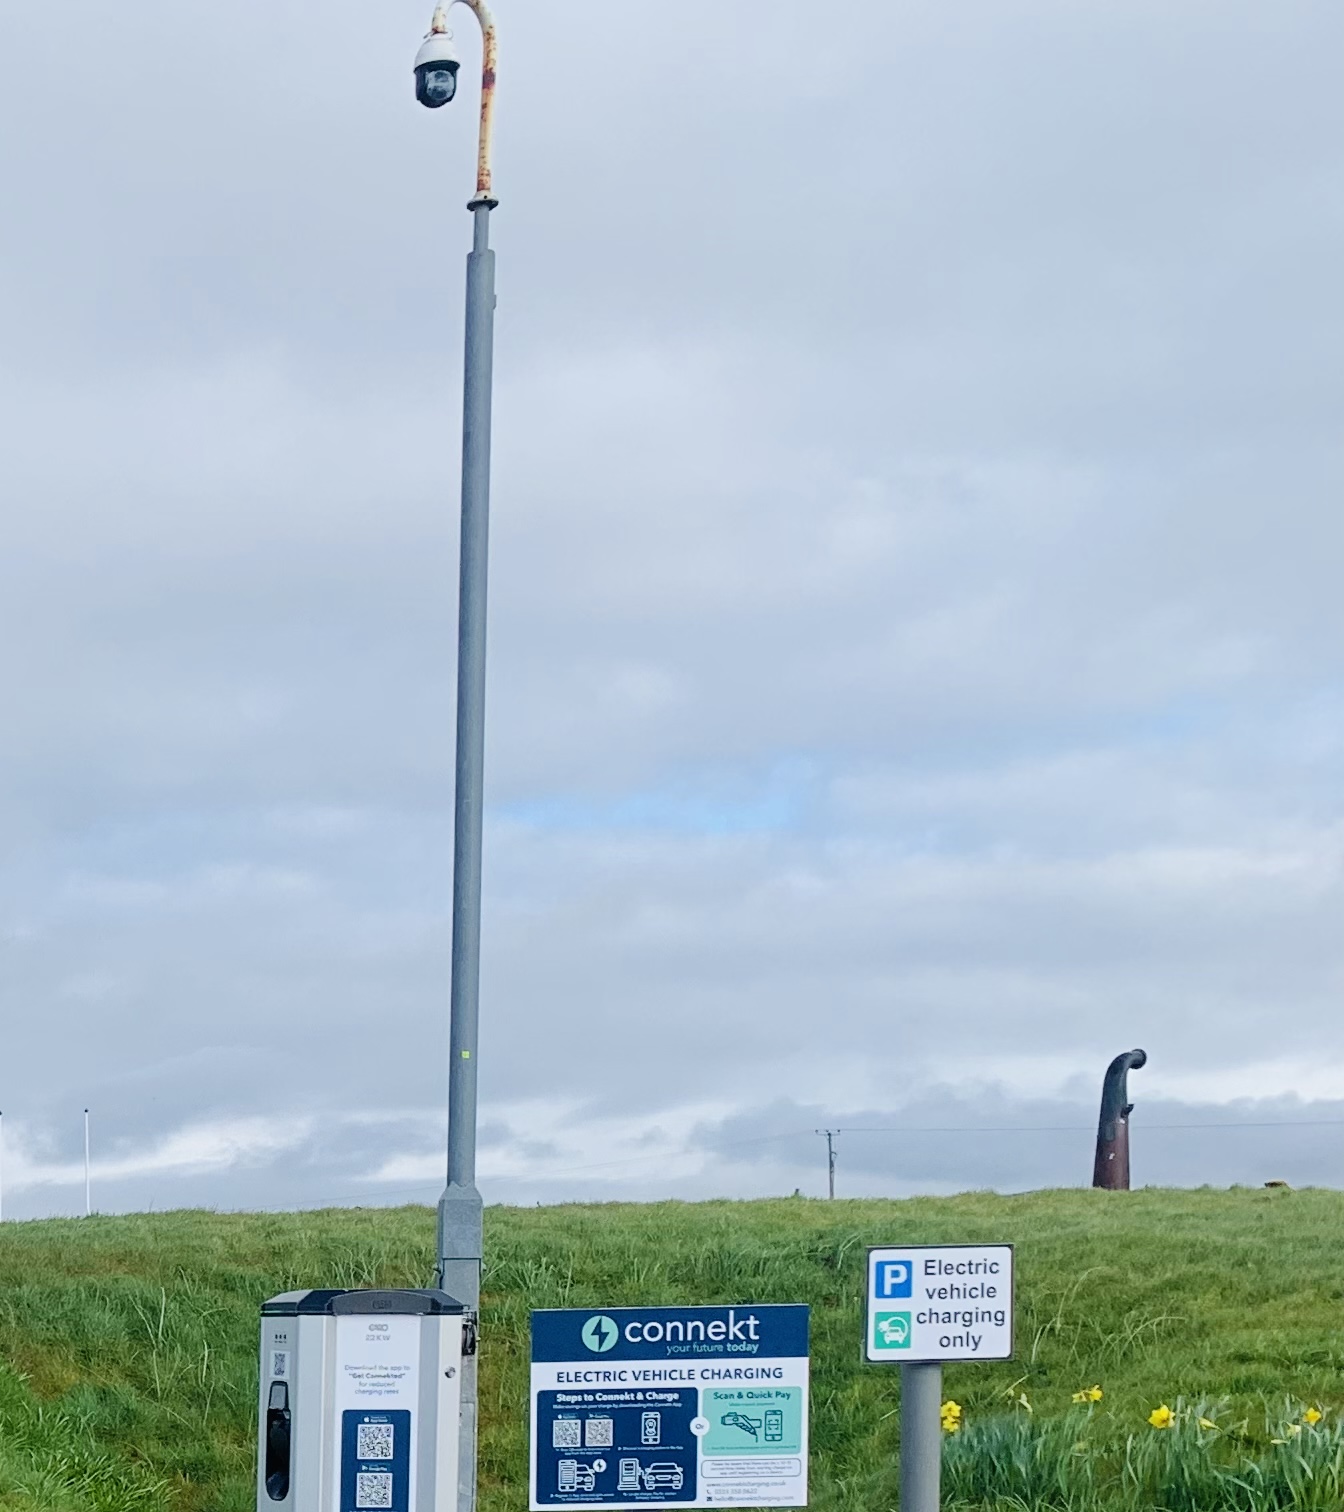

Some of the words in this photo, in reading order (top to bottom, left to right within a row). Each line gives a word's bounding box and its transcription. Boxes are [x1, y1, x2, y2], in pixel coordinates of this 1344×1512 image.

[924, 1258, 1000, 1276] Electric
[884, 1264, 908, 1296] P
[925, 1282, 997, 1300] vehicle
[624, 1309, 760, 1343] connekt
[916, 1307, 1006, 1327] charging
[666, 1344, 691, 1356] your
[692, 1342, 724, 1353] future
[726, 1340, 759, 1354] today
[939, 1331, 983, 1351] only
[556, 1370, 628, 1383] ELECTRIC
[632, 1369, 696, 1381] VEHICLE
[700, 1367, 783, 1380] CHARGING
[556, 1393, 582, 1404] Steps
[584, 1393, 594, 1402] to
[595, 1391, 635, 1402] Connekt
[636, 1391, 645, 1401] &
[645, 1391, 680, 1403] Charge
[713, 1391, 735, 1400] Scan
[736, 1391, 744, 1399] &
[746, 1390, 773, 1399] Quick
[775, 1390, 791, 1400] Pay
